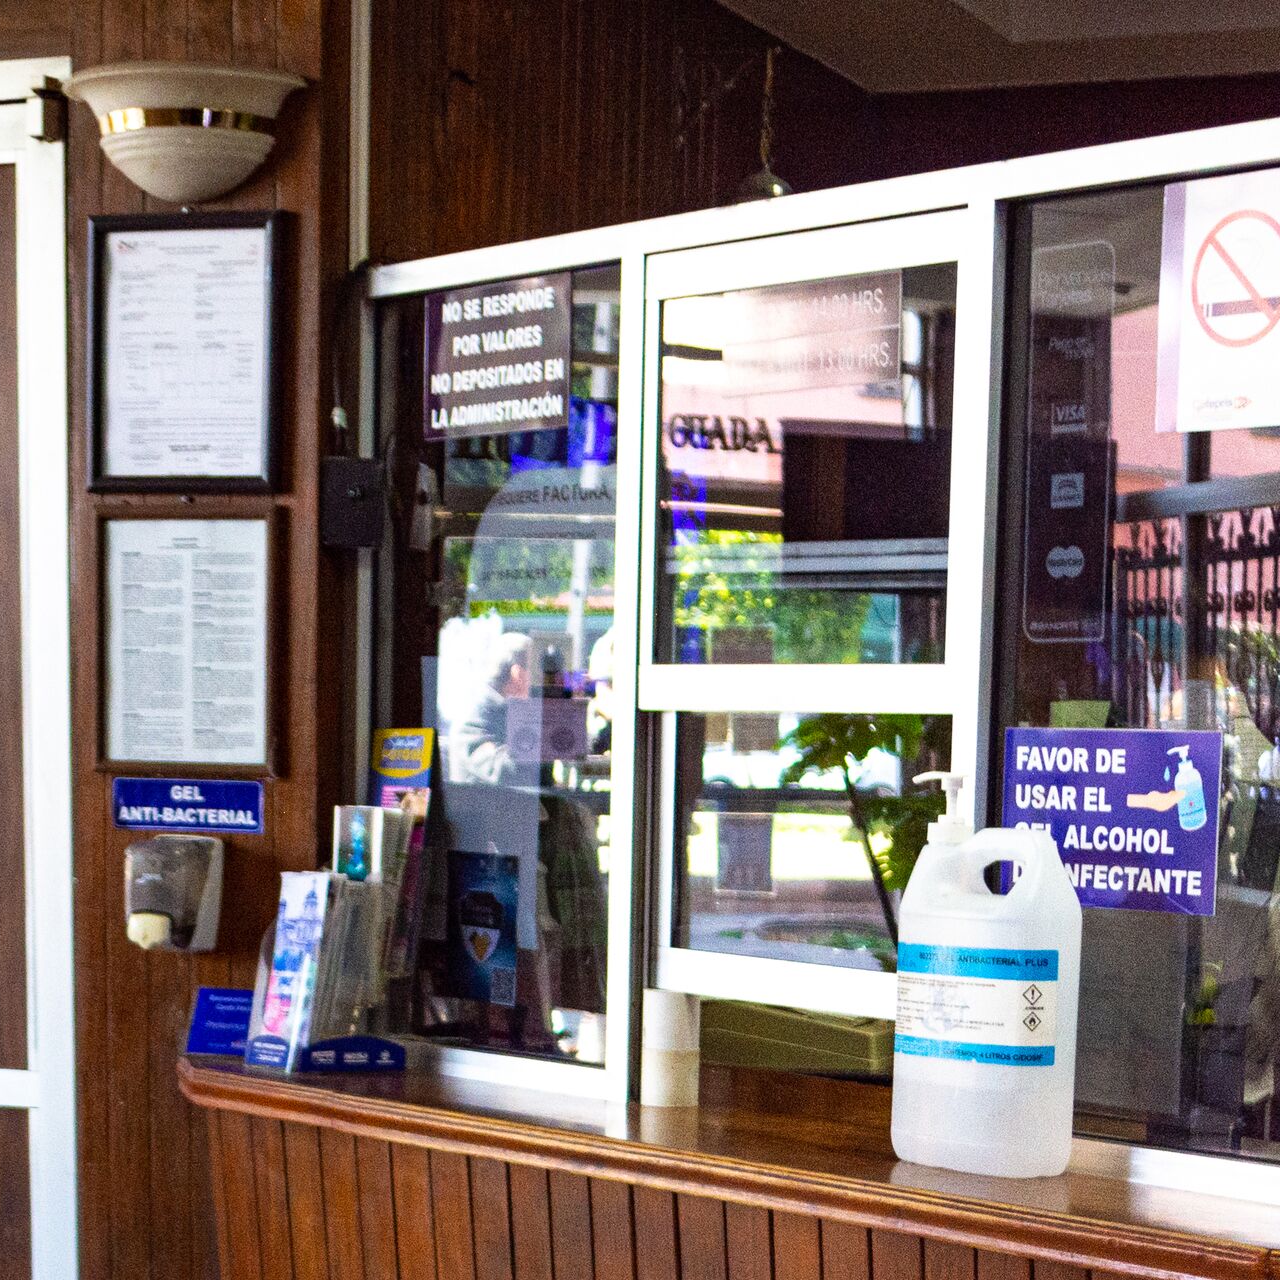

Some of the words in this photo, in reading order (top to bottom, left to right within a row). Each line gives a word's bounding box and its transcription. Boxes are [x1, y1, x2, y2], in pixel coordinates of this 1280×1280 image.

[442, 301, 462, 323] NO
[463, 298, 481, 321] SE
[483, 287, 555, 317] RESPONDE
[453, 334, 481, 357] POR
[482, 325, 542, 353] VALORES
[431, 372, 451, 394] NO
[453, 361, 543, 392] DEPOSITADOS
[544, 358, 564, 380] EN
[431, 408, 448, 429] LA
[450, 391, 563, 426] ADMINISTRACIÓN
[1056, 405, 1085, 421] VISA
[1016, 746, 1089, 773] FAVOR
[1095, 748, 1126, 774] DE
[170, 785, 205, 802] GEL
[1015, 784, 1077, 811] USAR
[1084, 787, 1112, 812] EL
[119, 806, 257, 826] ANTI-BACTERIAL
[1063, 825, 1174, 854] ALCOHOL
[1012, 860, 1202, 896] DNFECTANTE
[1025, 958, 1049, 967] PLUS
